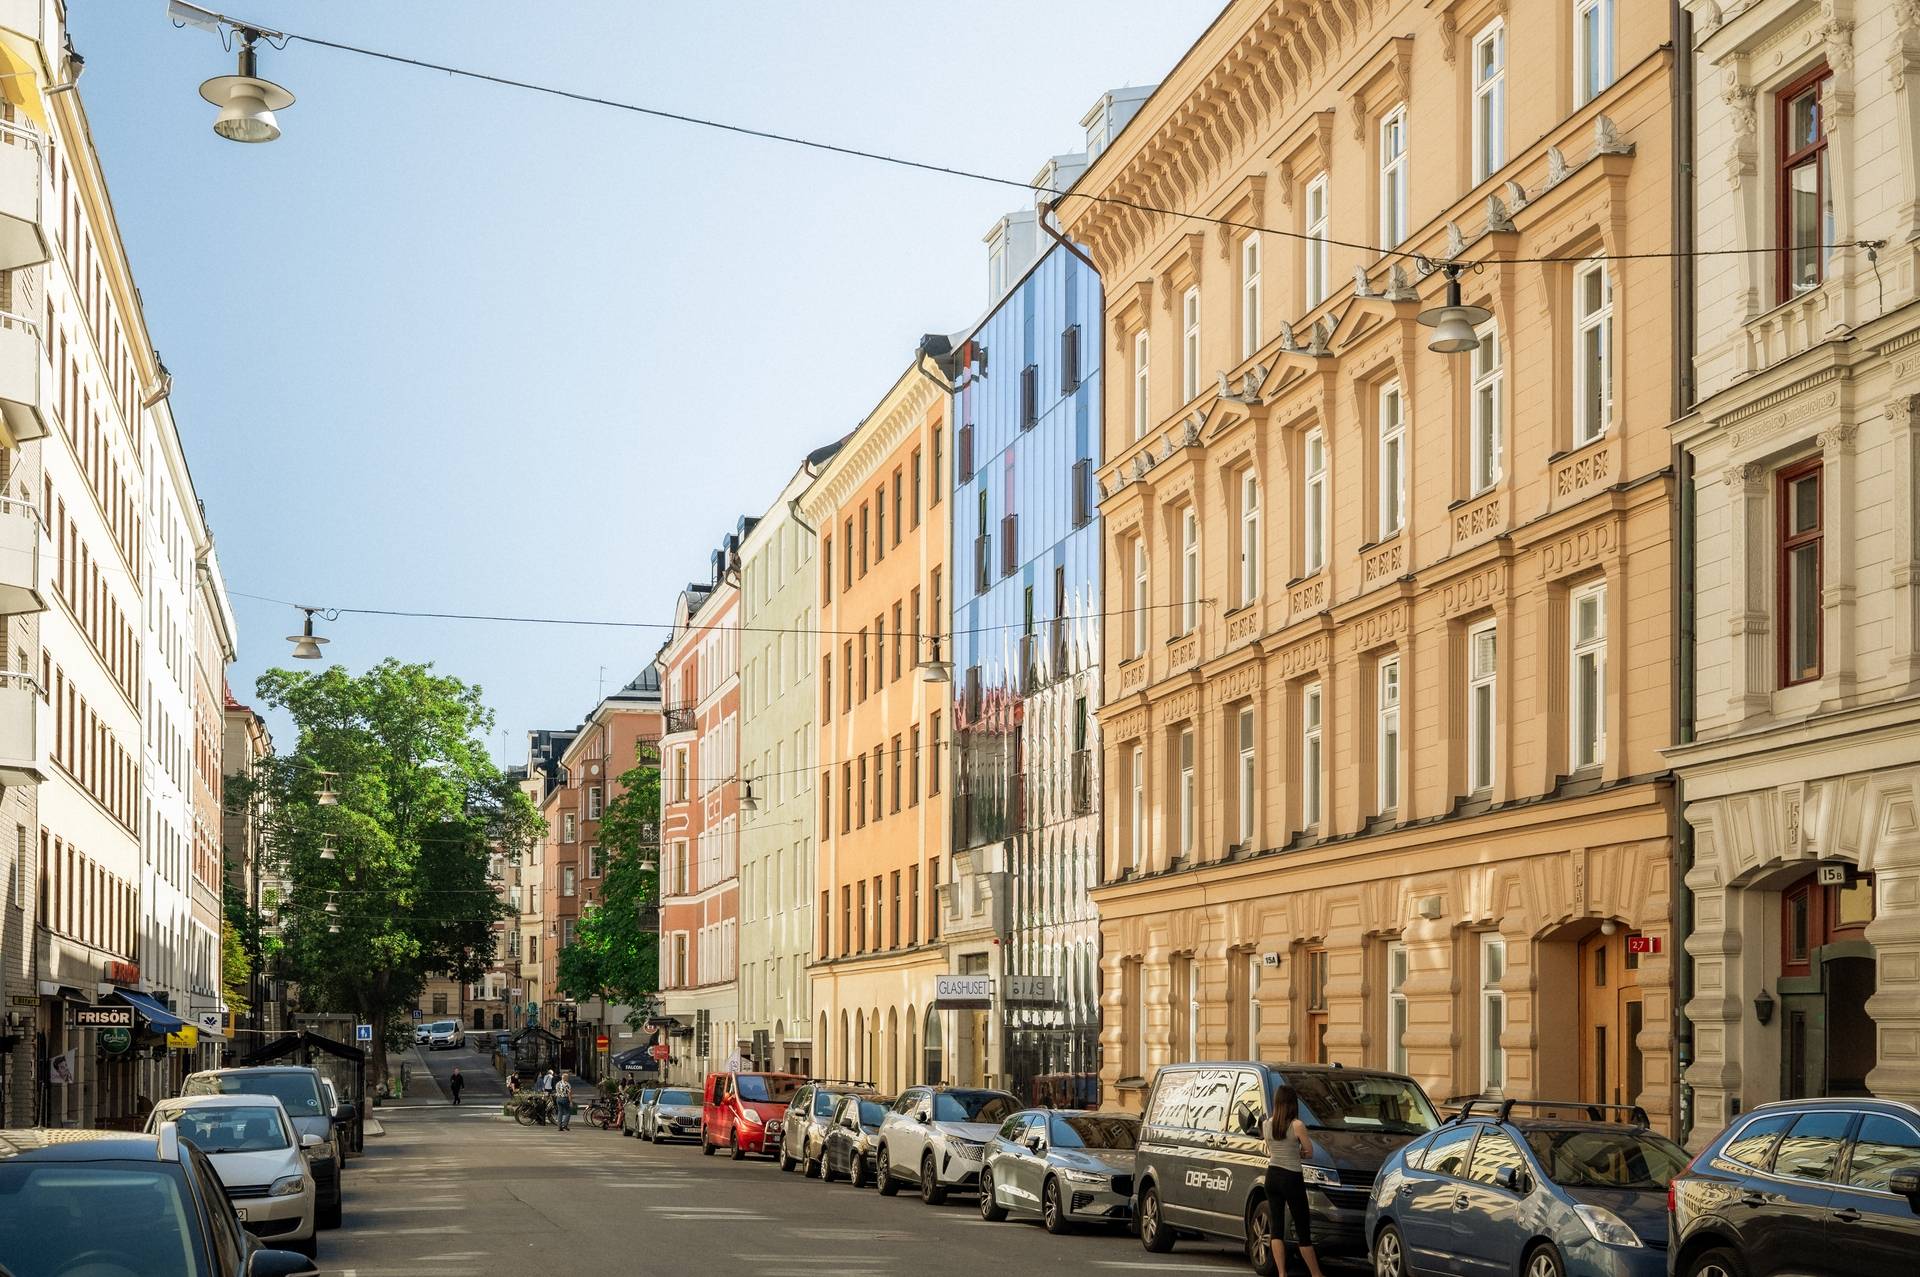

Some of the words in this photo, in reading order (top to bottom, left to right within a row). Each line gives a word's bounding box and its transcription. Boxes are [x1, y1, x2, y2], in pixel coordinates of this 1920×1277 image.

[1823, 869, 1842, 880] 15B
[939, 981, 987, 995] GLASHUSET
[78, 1009, 130, 1023] FRISÖR
[1185, 1170, 1229, 1191] 08Padel
